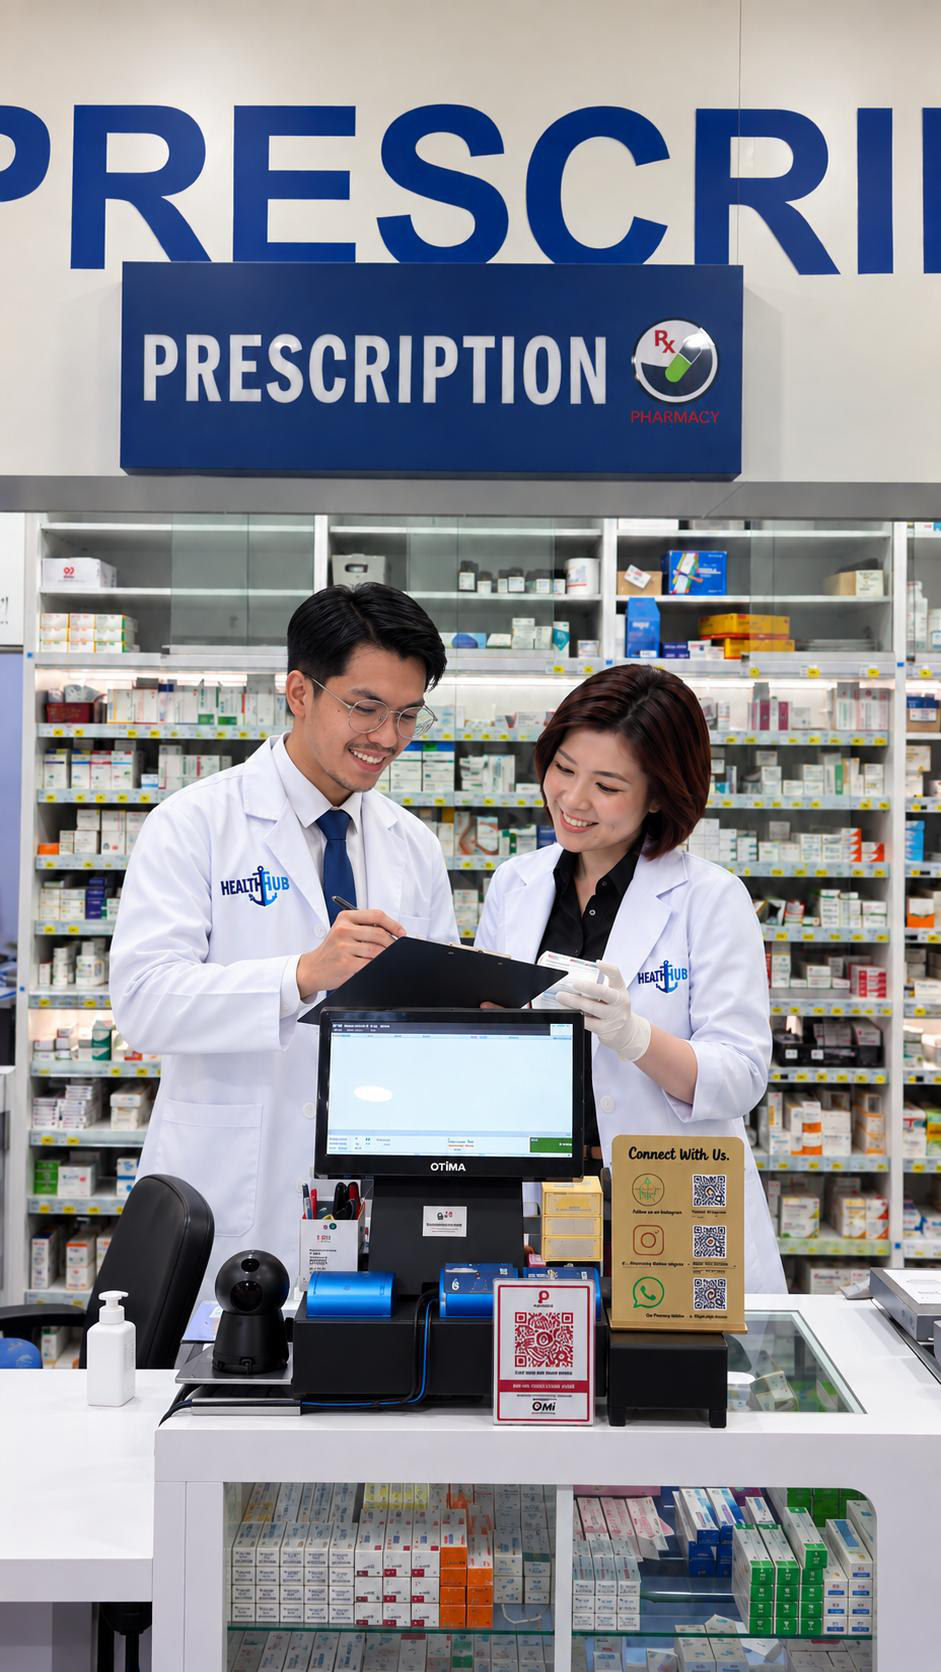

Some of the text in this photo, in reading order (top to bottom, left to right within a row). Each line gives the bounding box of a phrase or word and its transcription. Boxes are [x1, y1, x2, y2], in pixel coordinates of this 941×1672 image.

[143, 333, 607, 404] PRESCRIPTION
[630, 410, 720, 424] PHARMACY
[628, 1146, 730, 1161] Connect With Us.
